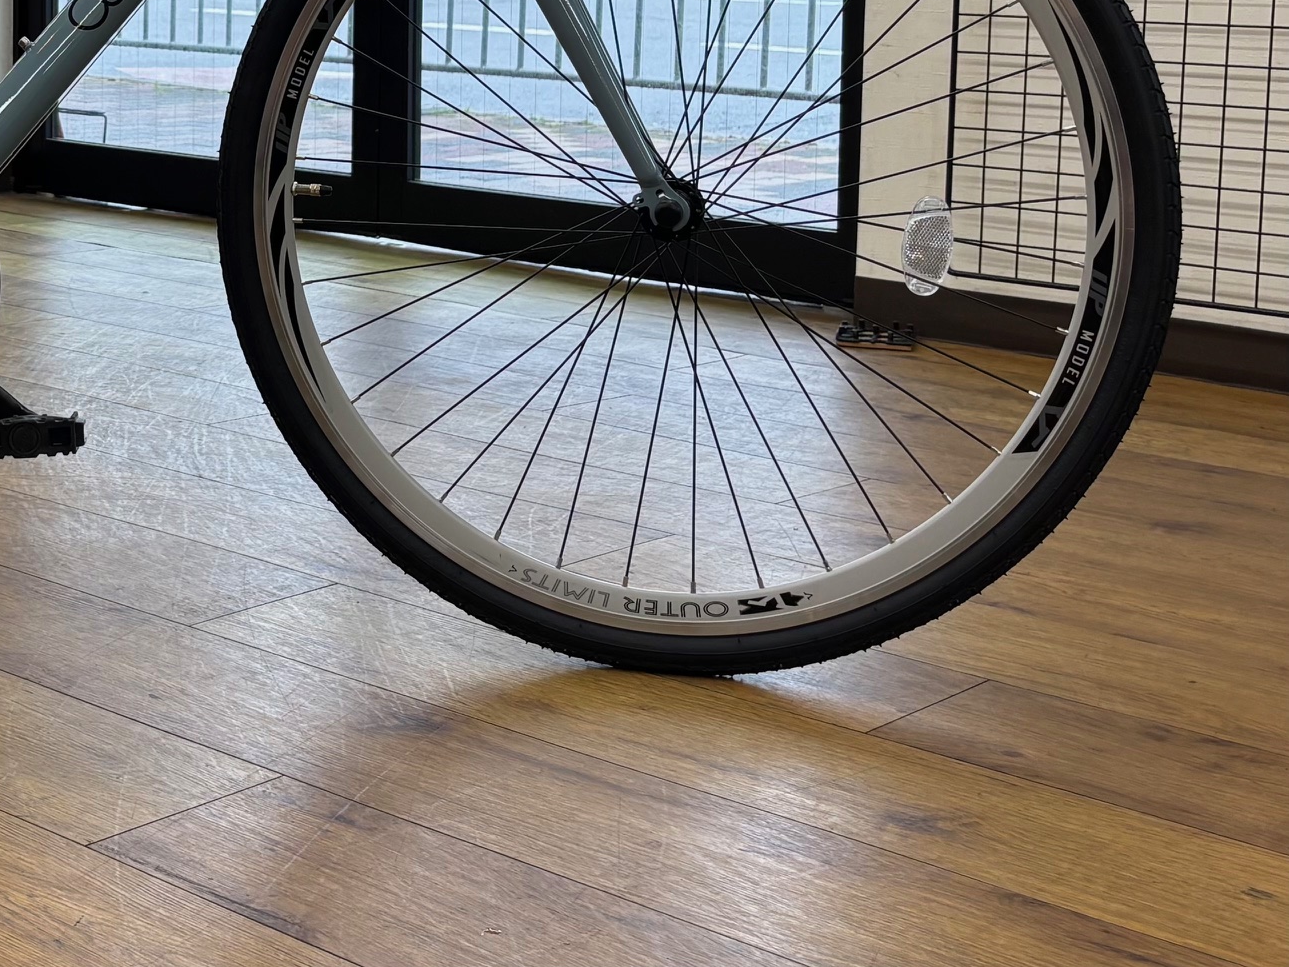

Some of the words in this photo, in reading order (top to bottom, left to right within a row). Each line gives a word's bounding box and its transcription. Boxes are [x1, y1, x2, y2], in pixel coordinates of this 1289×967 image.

[286, 49, 315, 100] MODEL
[1061, 329, 1095, 386] MODEL
[520, 568, 610, 608] LIMITS
[623, 595, 730, 618] OUTER
